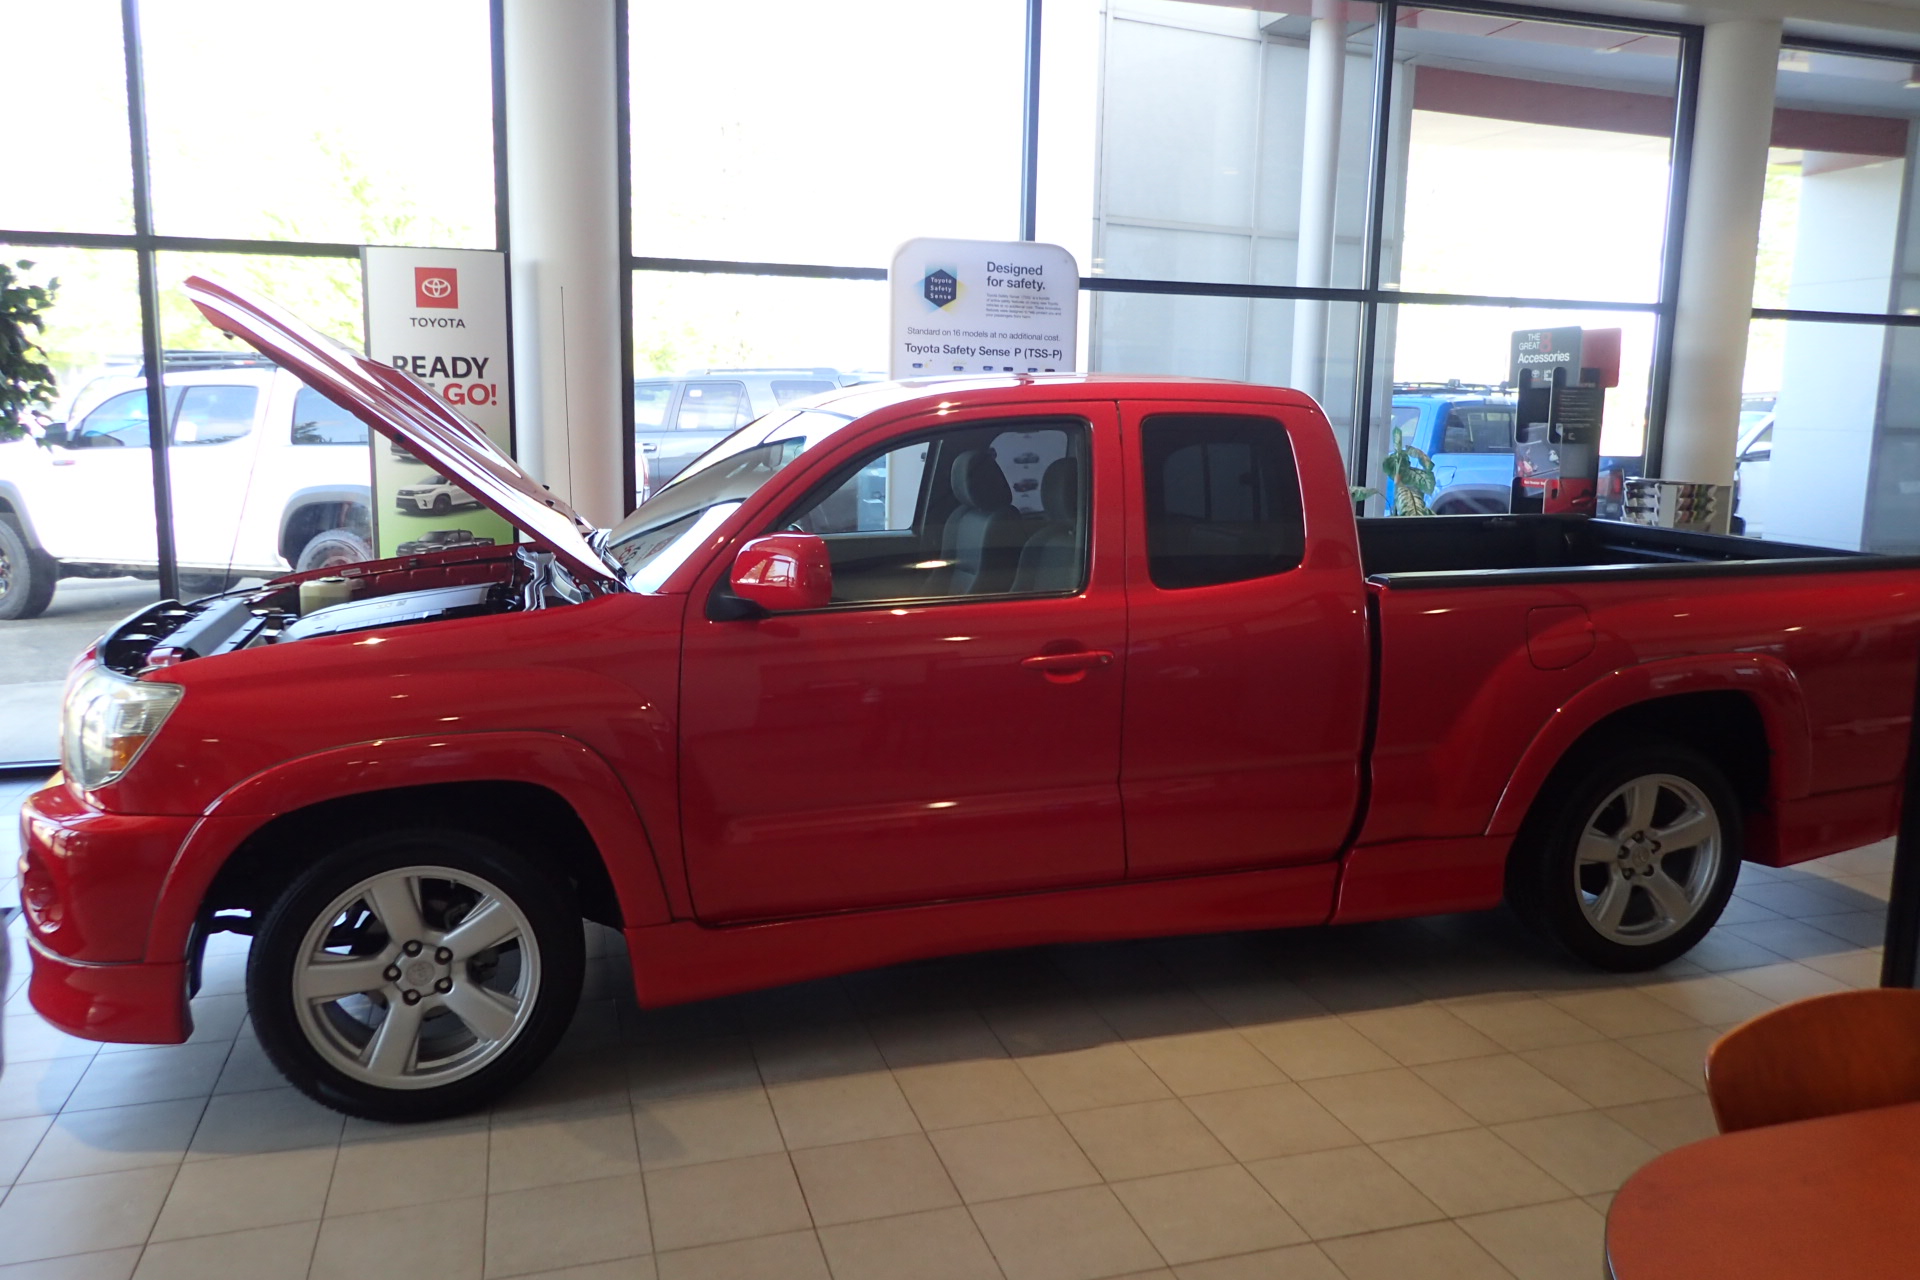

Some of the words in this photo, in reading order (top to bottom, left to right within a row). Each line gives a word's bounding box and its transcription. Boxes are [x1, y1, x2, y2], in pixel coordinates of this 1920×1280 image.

[987, 262, 1043, 277] Designed
[930, 285, 952, 293] Safety
[987, 276, 1003, 287] for
[1007, 278, 1045, 292] safety.
[410, 317, 466, 328] TOYOTA
[907, 327, 940, 336] Standard
[962, 330, 988, 338] models
[1009, 331, 1042, 340] additional
[1044, 333, 1060, 341] cost.
[1528, 333, 1540, 341] THE
[905, 343, 939, 354] Toyota
[943, 344, 976, 356] Safety
[979, 346, 1010, 356] Sense
[1014, 348, 1021, 356] P
[1024, 348, 1062, 361] (TSS-P)
[1519, 341, 1540, 350] GREAT
[1518, 351, 1570, 364] Accessories
[392, 355, 490, 379] READY
[443, 383, 498, 406] GO!
